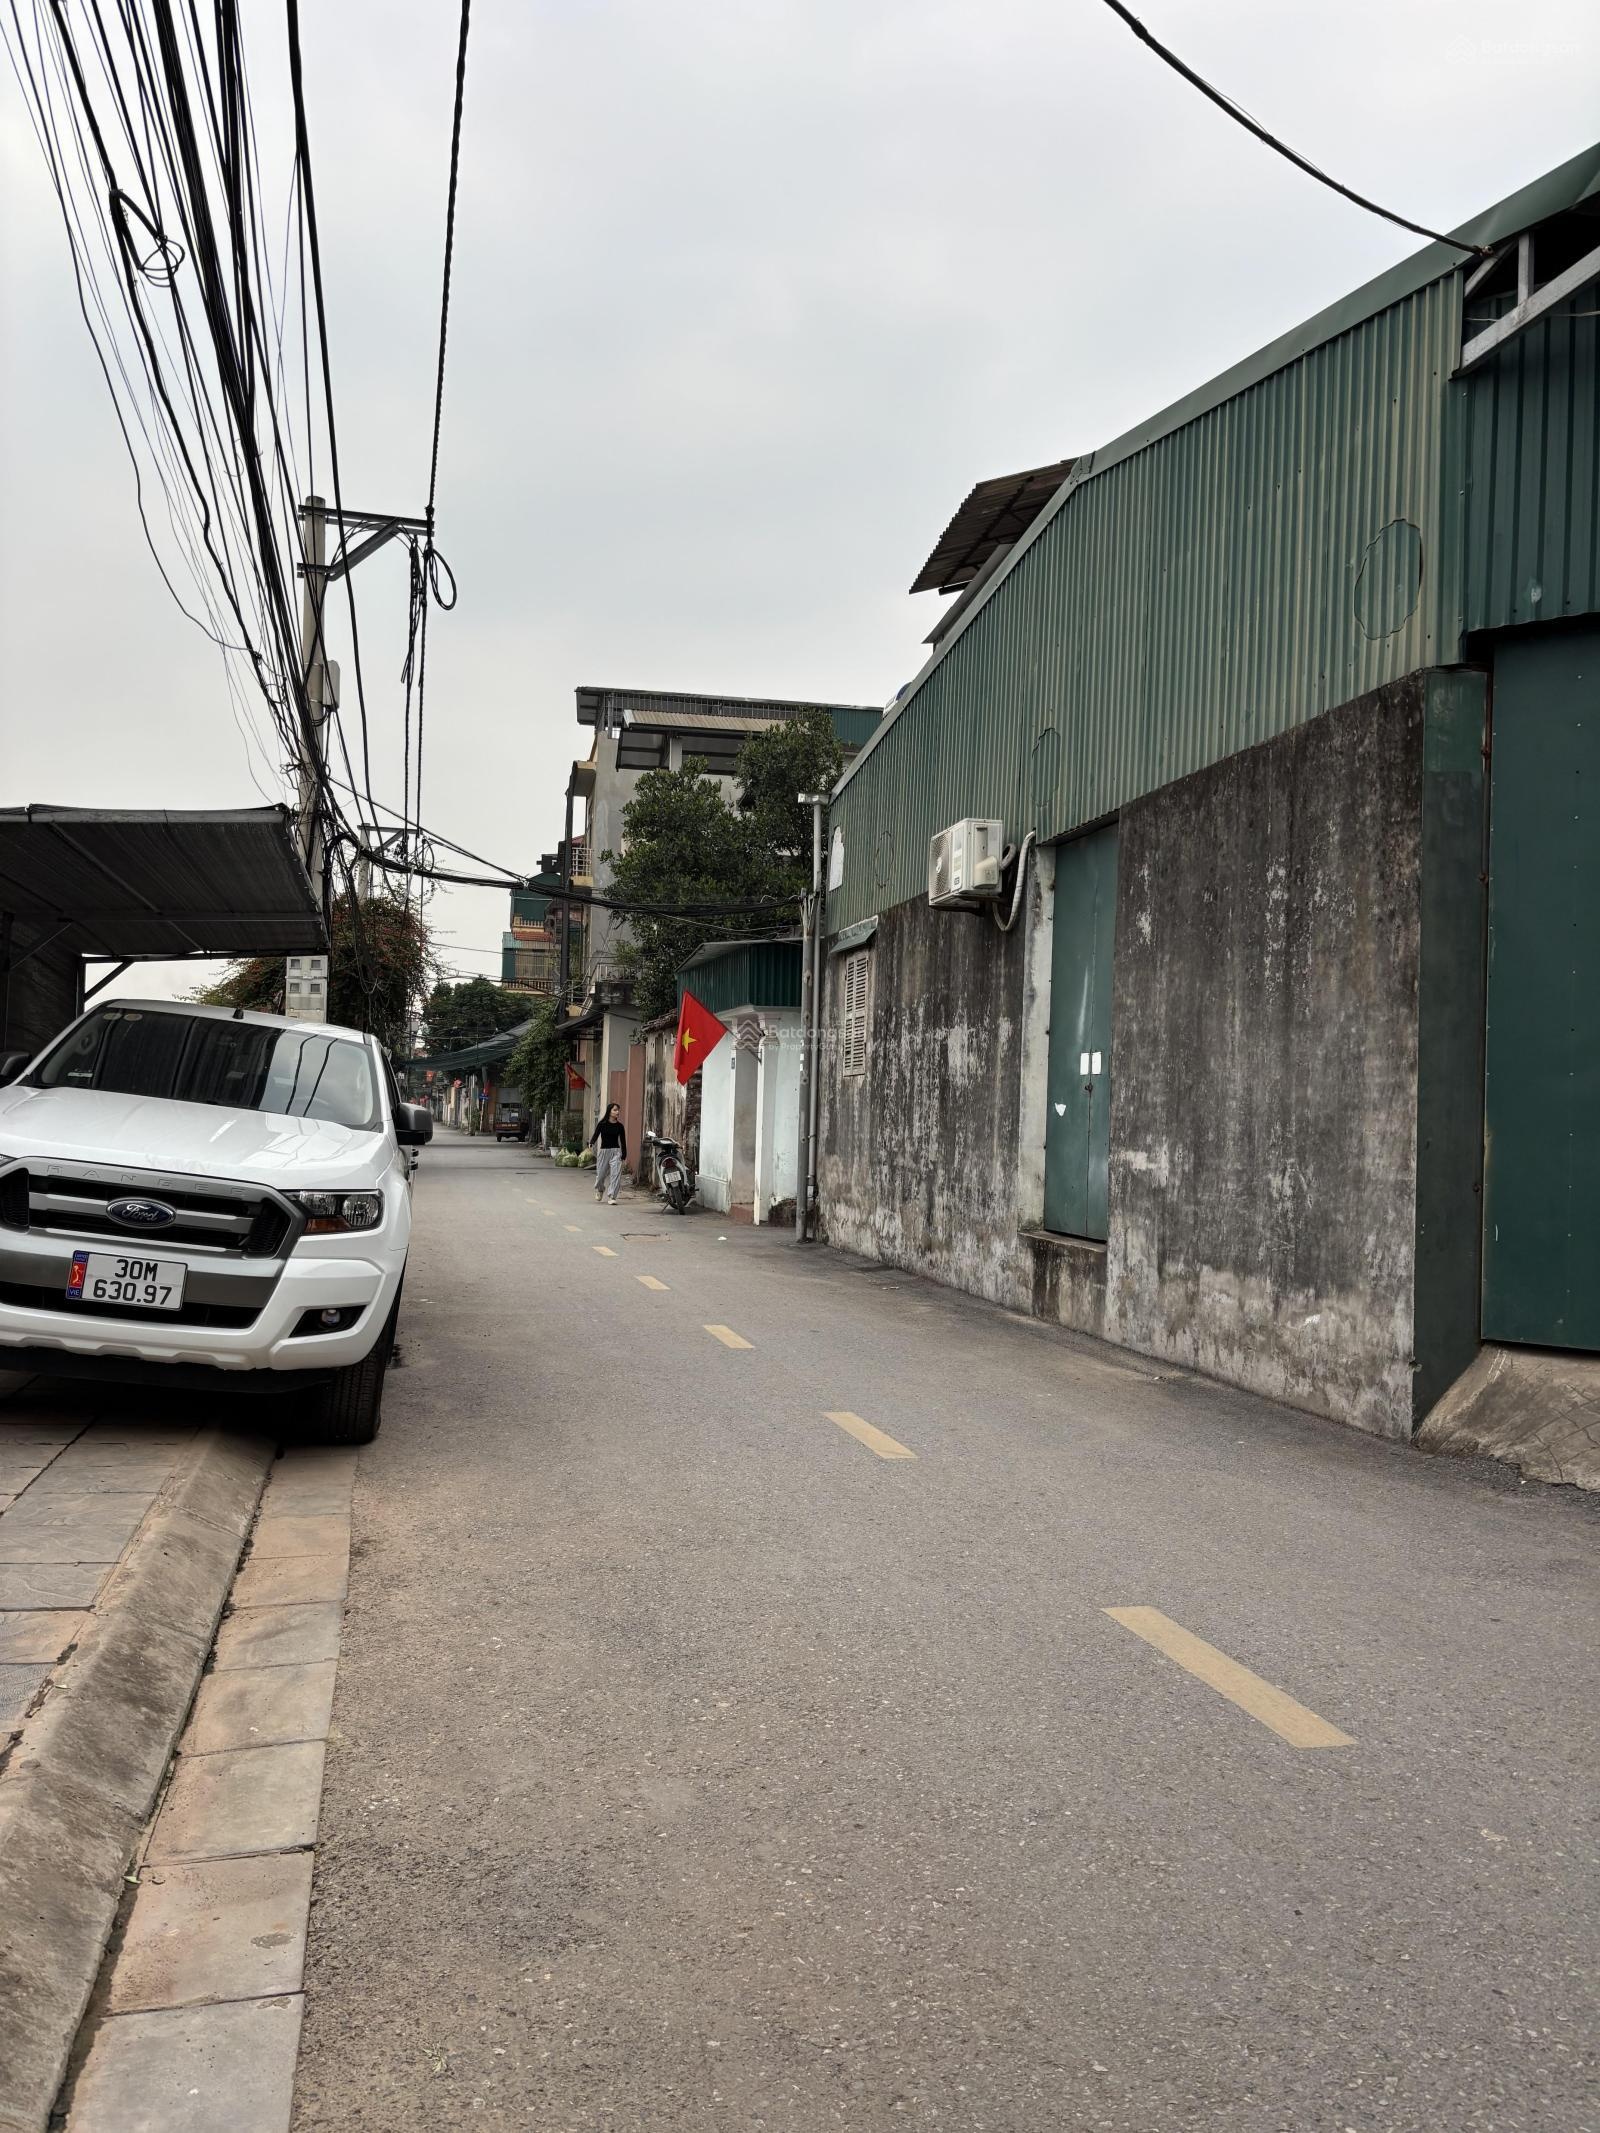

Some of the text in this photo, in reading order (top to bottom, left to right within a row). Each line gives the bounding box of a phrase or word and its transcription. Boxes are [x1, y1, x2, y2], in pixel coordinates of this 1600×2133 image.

[122, 1203, 160, 1221] Ford
[115, 1259, 159, 1282] 30M
[93, 1279, 172, 1305] 630.97
